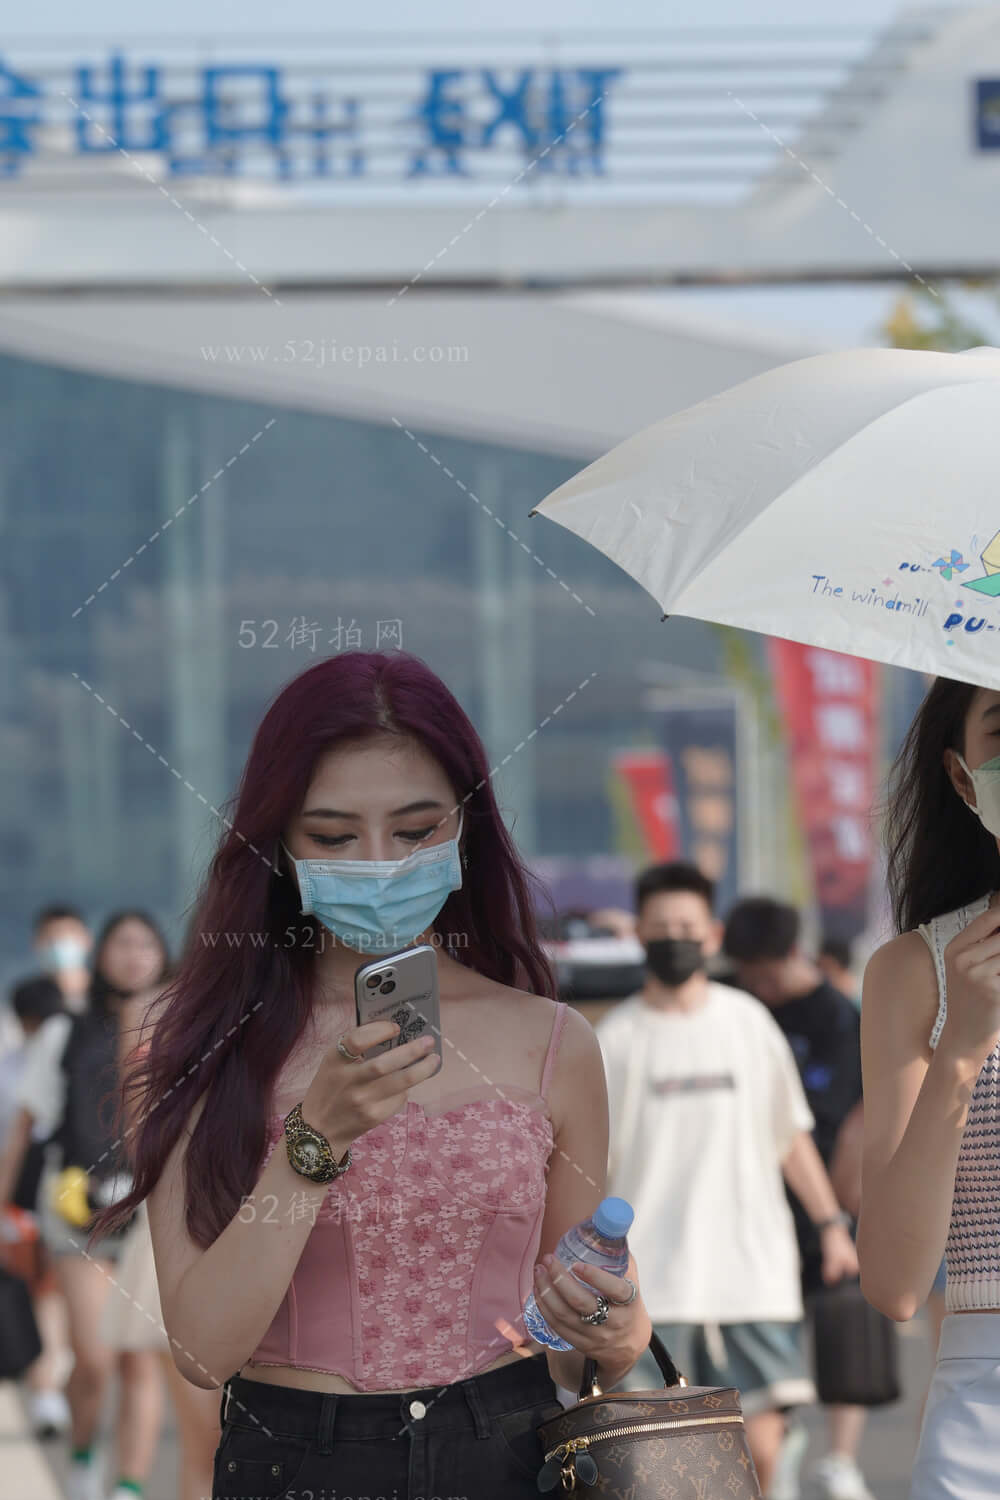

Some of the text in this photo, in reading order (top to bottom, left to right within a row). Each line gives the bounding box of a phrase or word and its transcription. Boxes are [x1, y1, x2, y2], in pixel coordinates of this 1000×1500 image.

[424, 68, 628, 156] EXIT
[812, 575, 928, 617] The windmill
